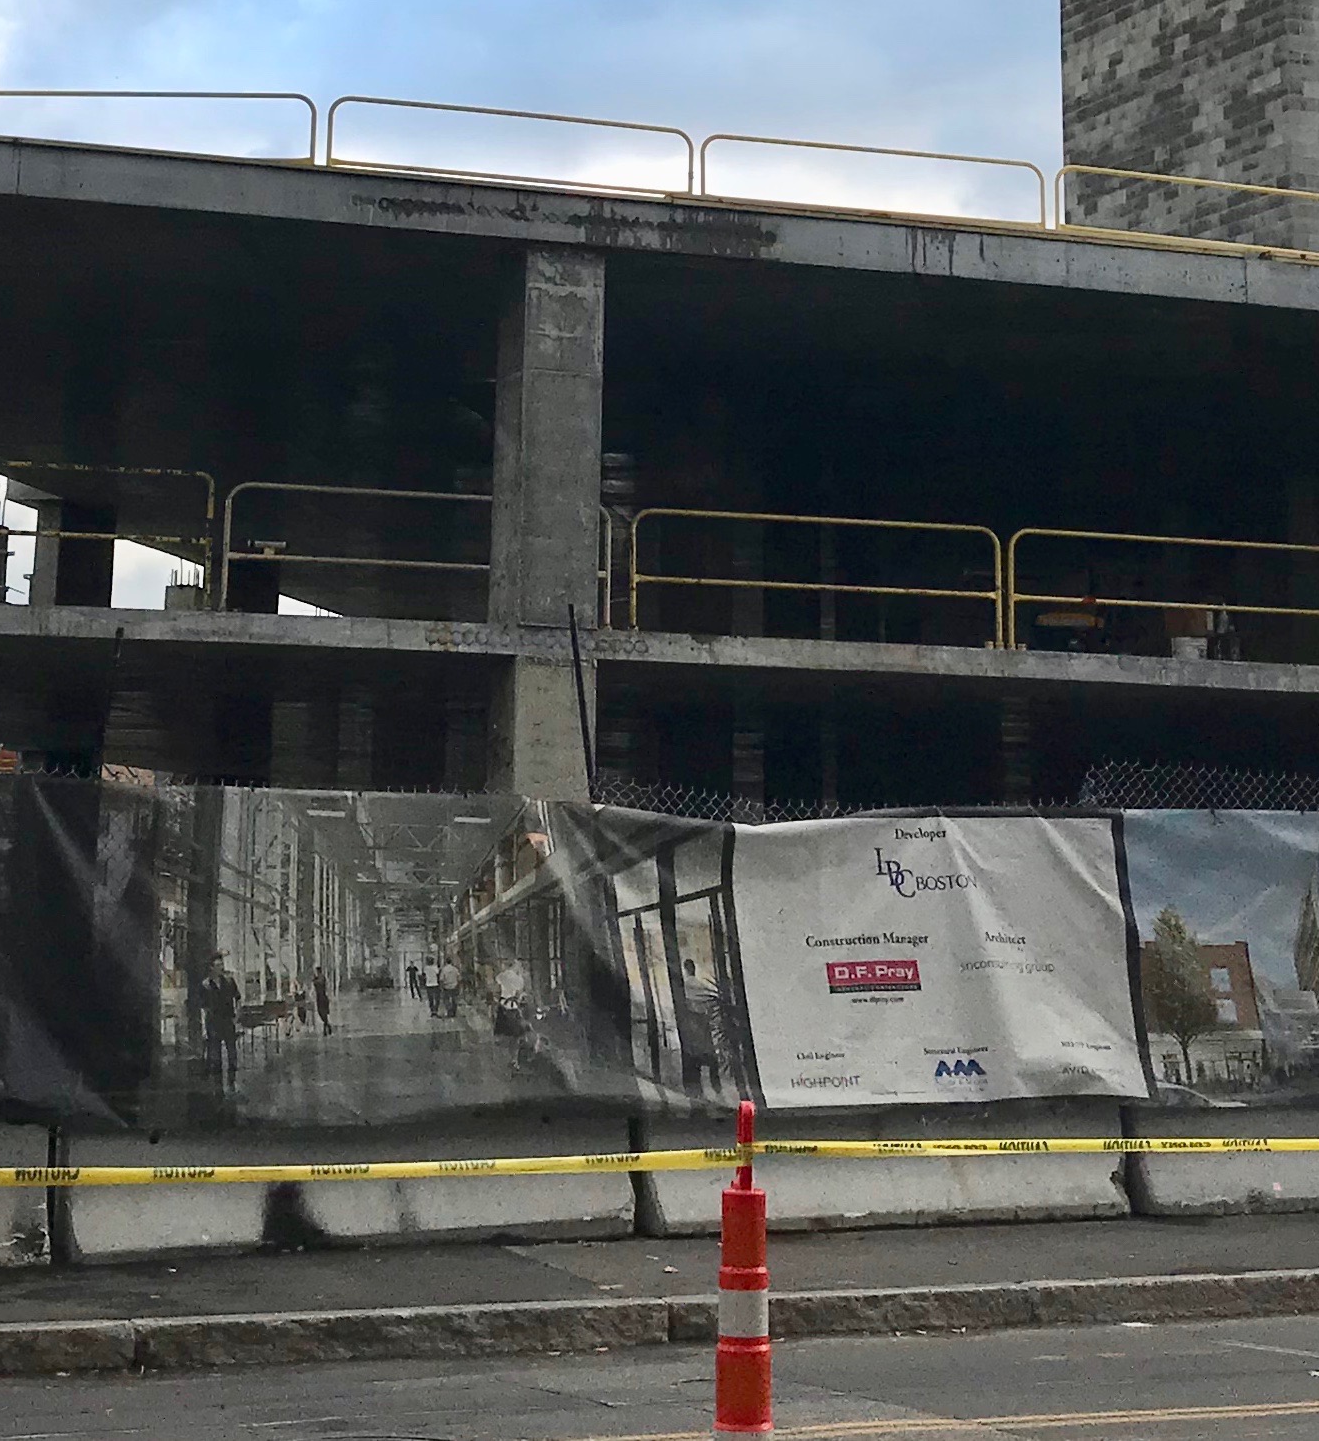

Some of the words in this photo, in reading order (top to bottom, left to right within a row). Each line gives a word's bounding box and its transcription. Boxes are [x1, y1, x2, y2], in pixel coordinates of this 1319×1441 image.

[894, 827, 947, 842] Developer
[805, 933, 881, 948] Construction
[883, 931, 929, 948] Manager
[834, 965, 872, 979] D.F.
[875, 964, 914, 980] Pray
